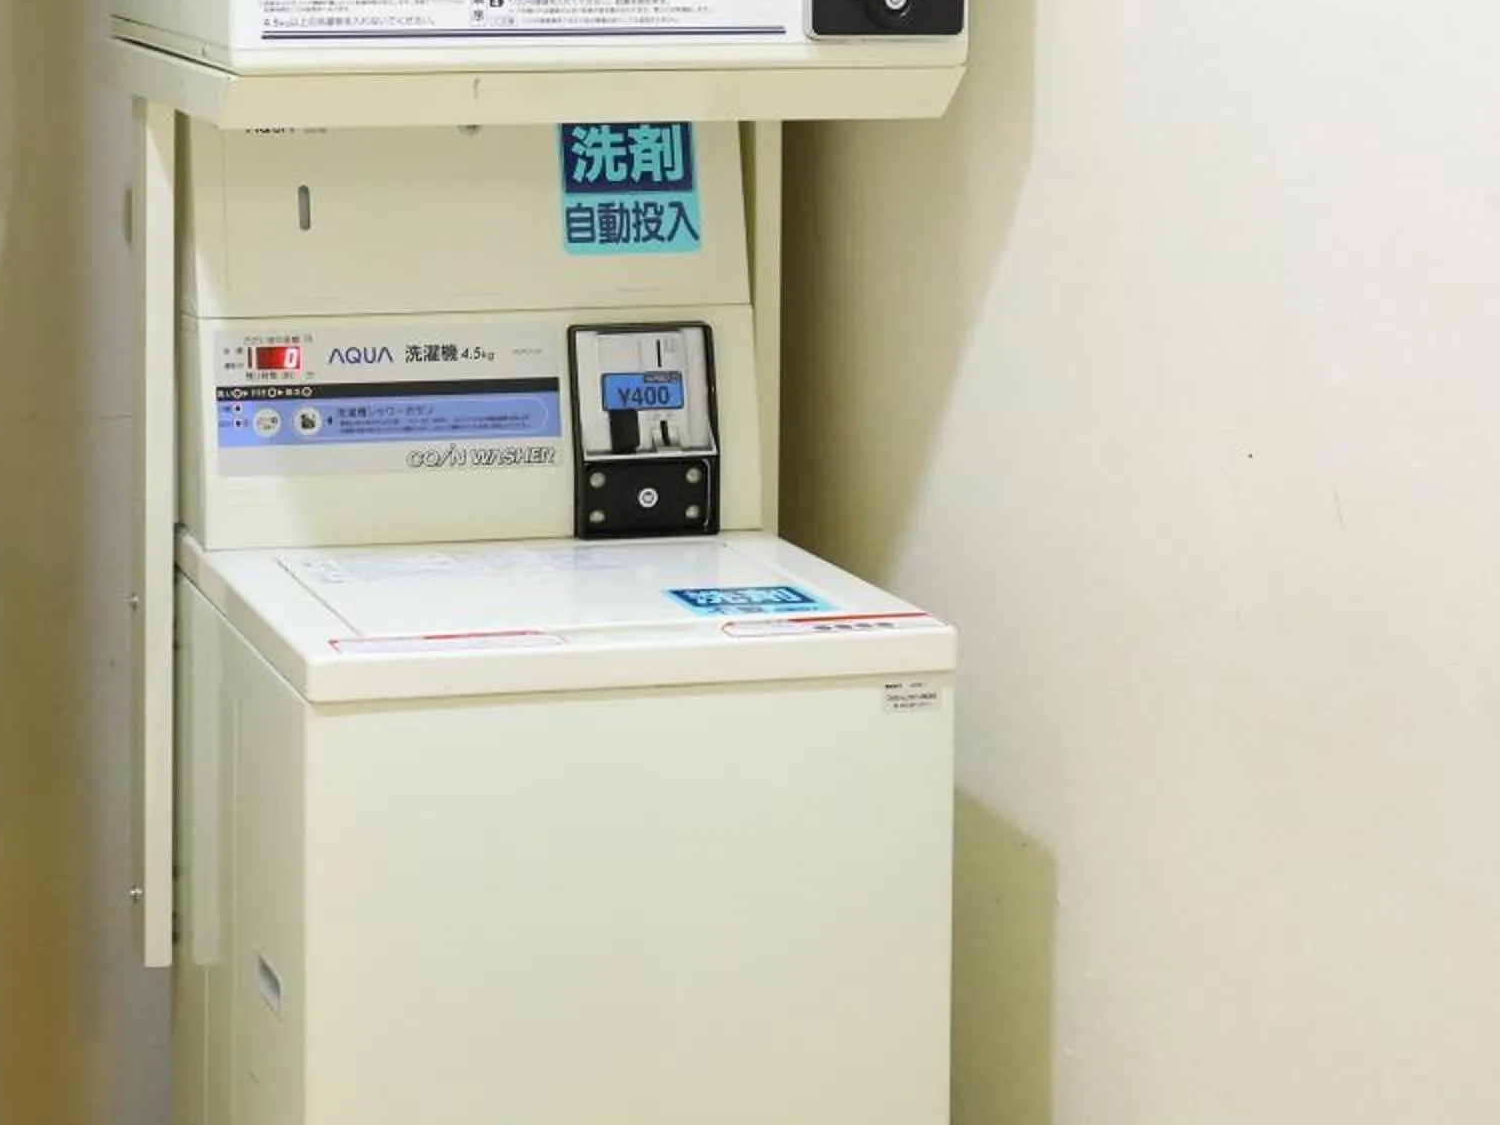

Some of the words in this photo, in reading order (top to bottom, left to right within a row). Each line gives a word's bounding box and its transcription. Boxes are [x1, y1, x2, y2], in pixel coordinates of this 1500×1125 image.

[571, 124, 683, 184] 洗剤
[565, 201, 700, 245] 自動投入
[285, 347, 299, 368] 0
[328, 346, 395, 364] AQUA
[405, 344, 459, 363] 洗濯機
[461, 346, 496, 362] 4.5kg
[472, 446, 556, 466] WASHER
